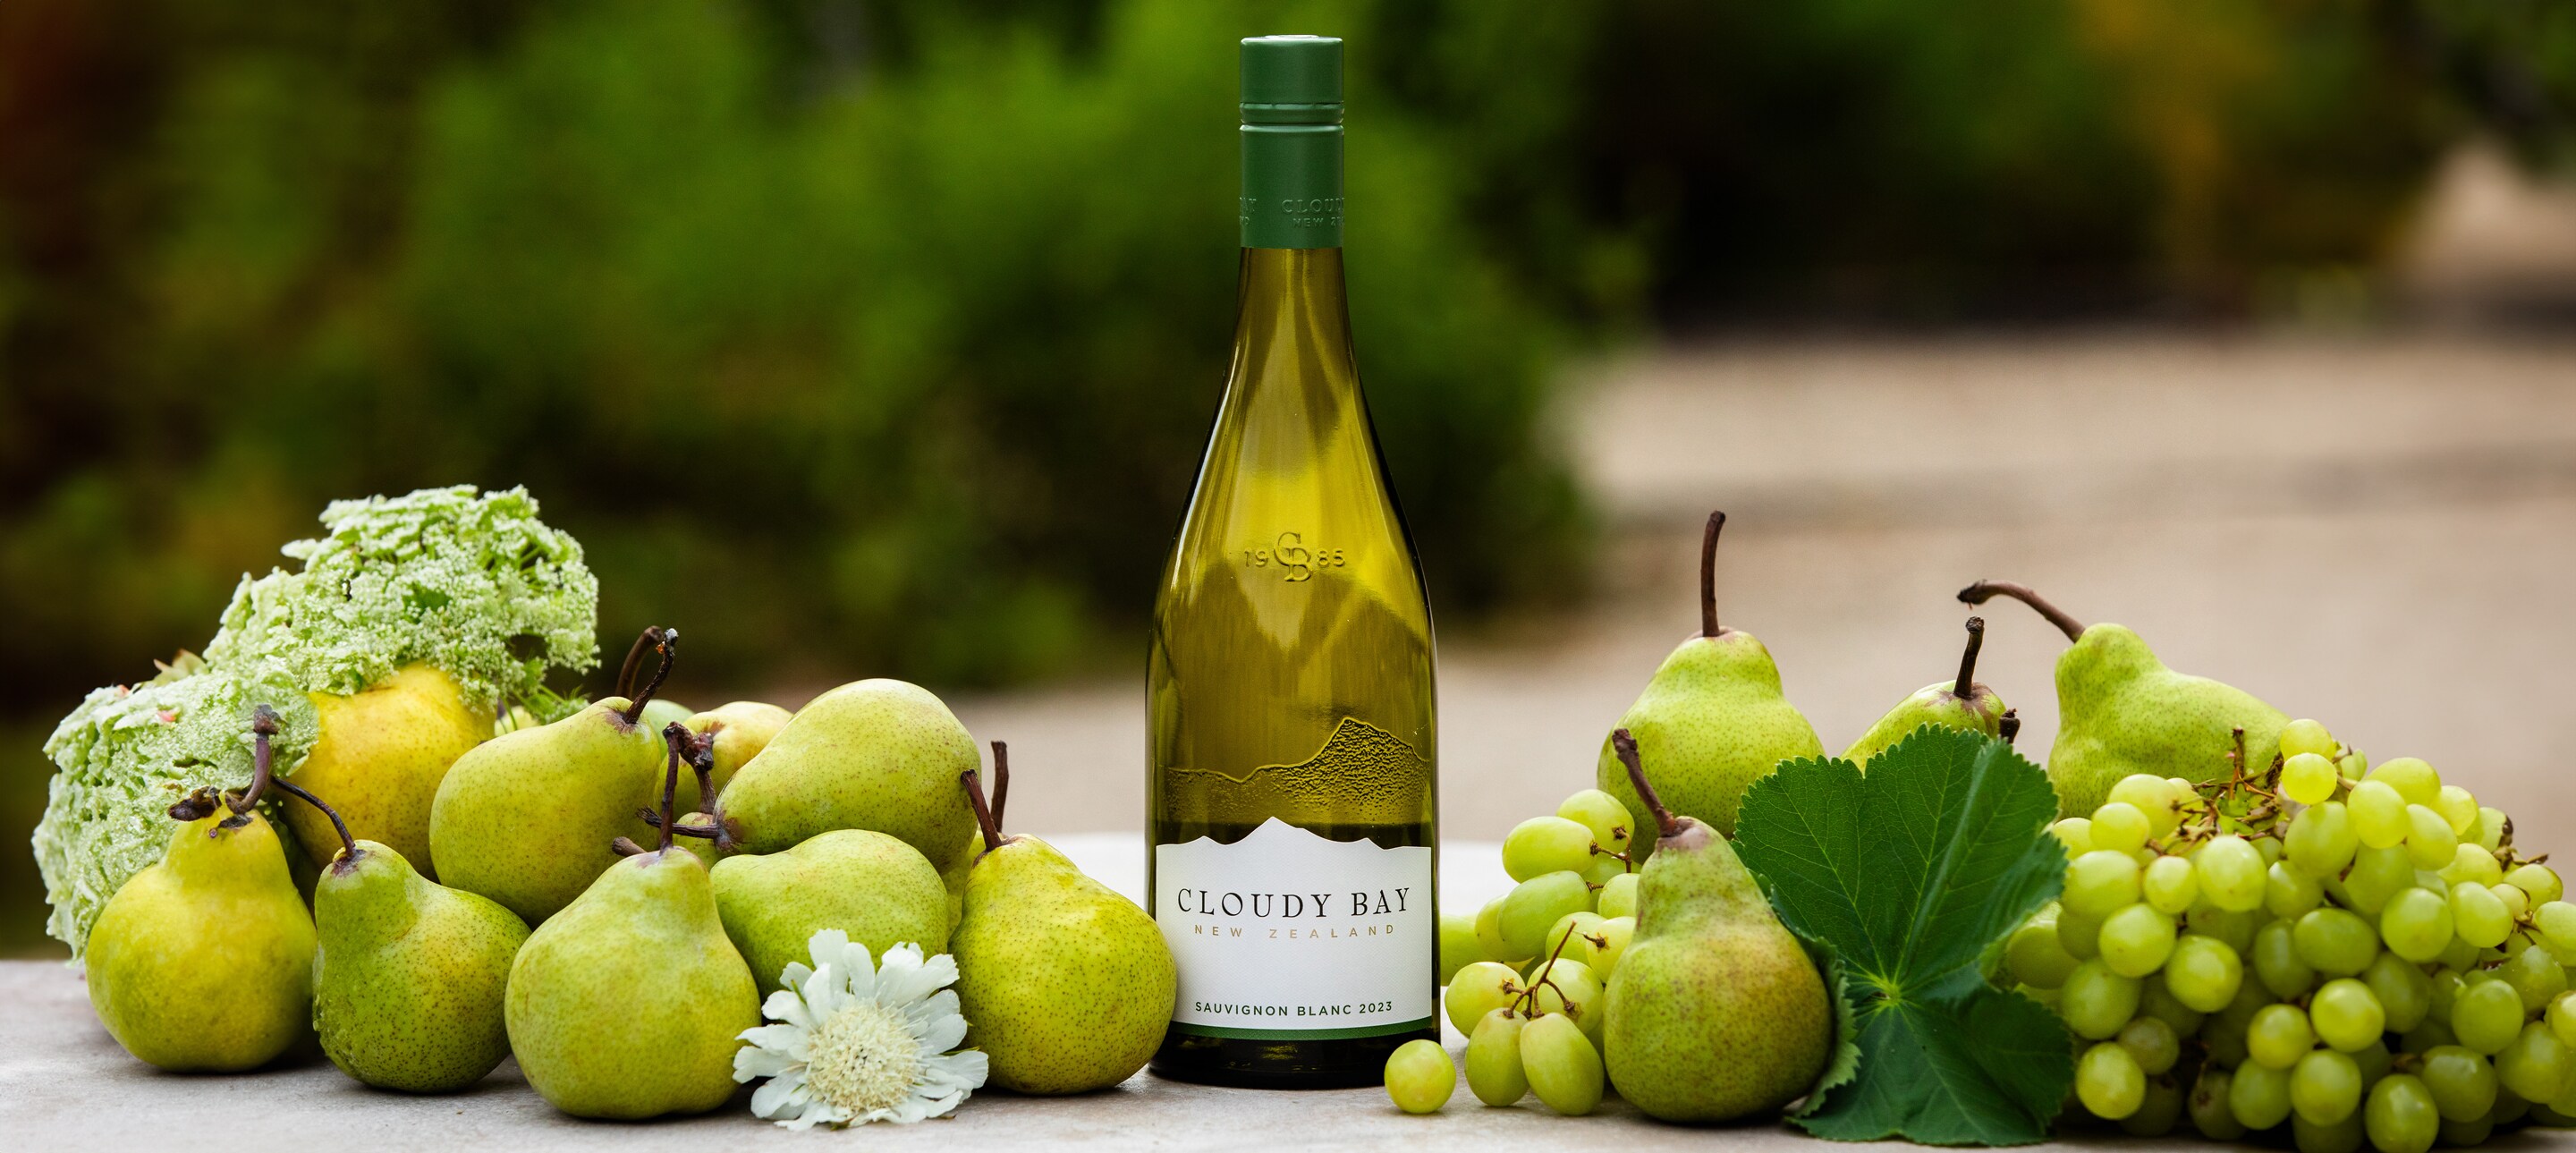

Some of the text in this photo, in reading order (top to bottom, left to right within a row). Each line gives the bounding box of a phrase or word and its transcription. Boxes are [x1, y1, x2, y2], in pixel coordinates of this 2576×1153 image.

[1240, 197, 1257, 214] AY
[1293, 217, 1324, 228] NEW
[1244, 547, 1269, 568] 19
[1317, 547, 1346, 568] 85
[1177, 887, 1410, 919] CLOUDY BAY
[1194, 924, 1394, 939] NEW ZEALAND
[1195, 1001, 1393, 1016] SAUVIGNON BLANC 2023
